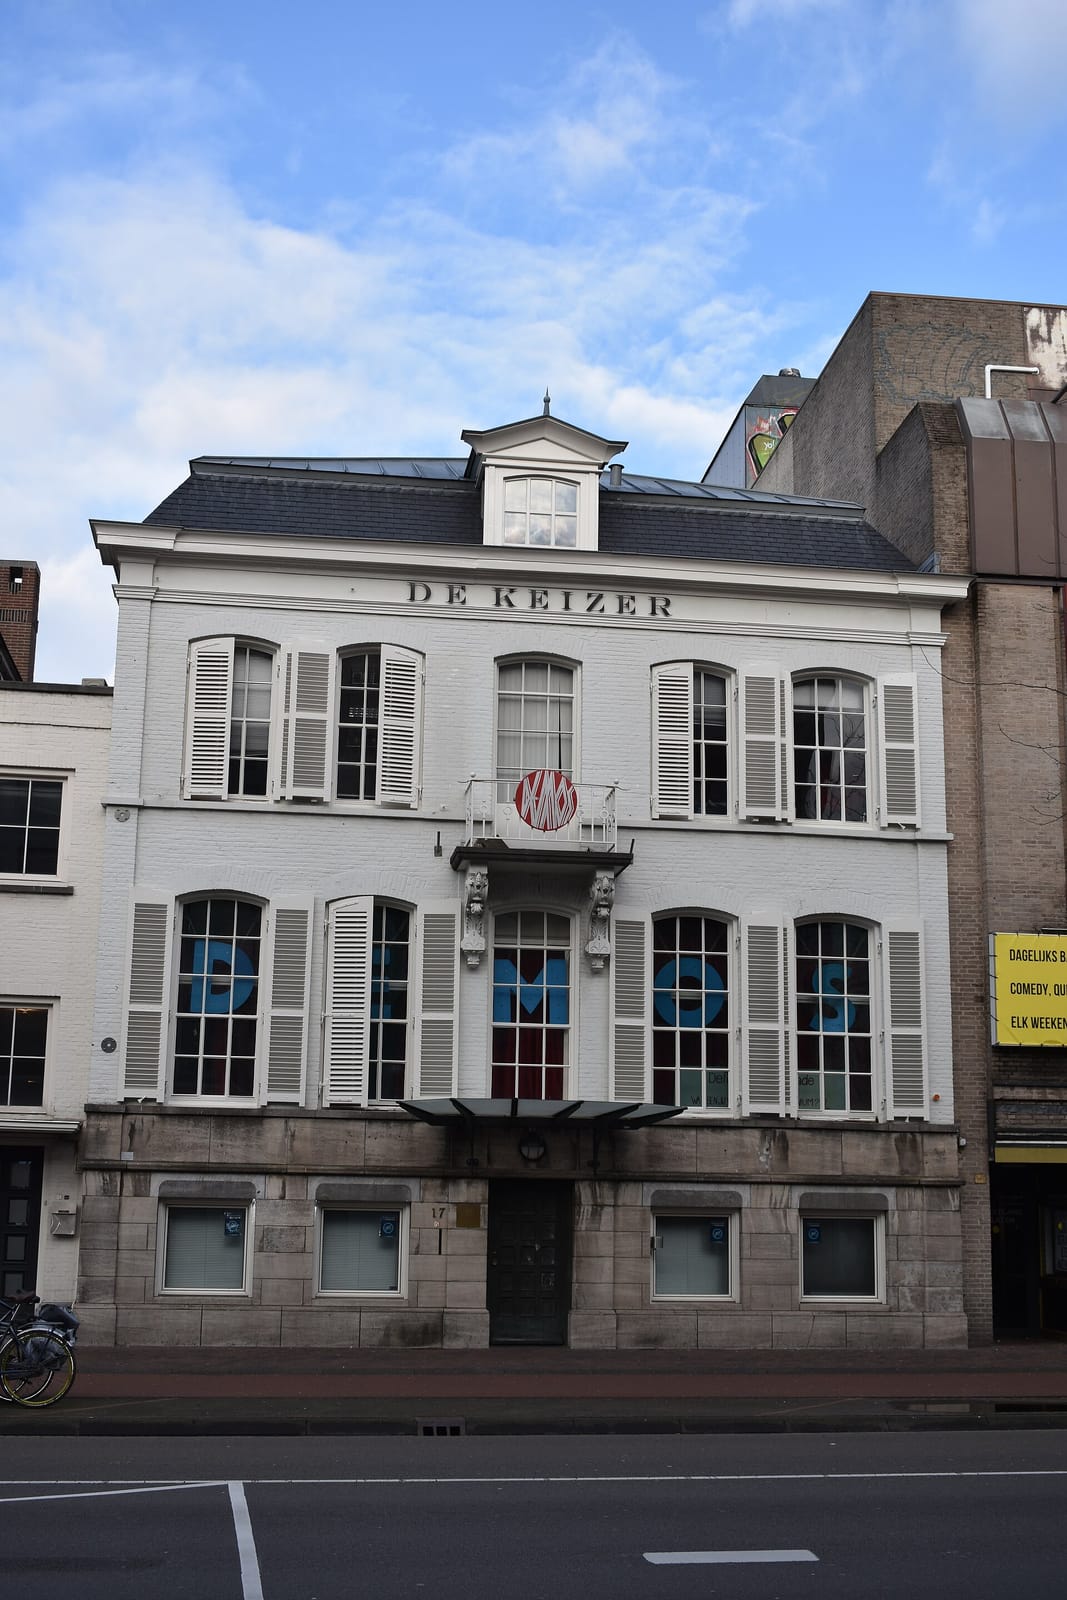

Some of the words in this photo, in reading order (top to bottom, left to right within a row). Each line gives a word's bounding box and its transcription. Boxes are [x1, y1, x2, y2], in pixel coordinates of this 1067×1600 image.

[406, 582, 467, 605] DE
[494, 587, 672, 617] KEIZER
[1009, 949, 1057, 962] DAGELIJKS
[1010, 982, 1052, 996] COMEDY,
[1011, 1016, 1028, 1028] ELK
[431, 1207, 446, 1219] 17
